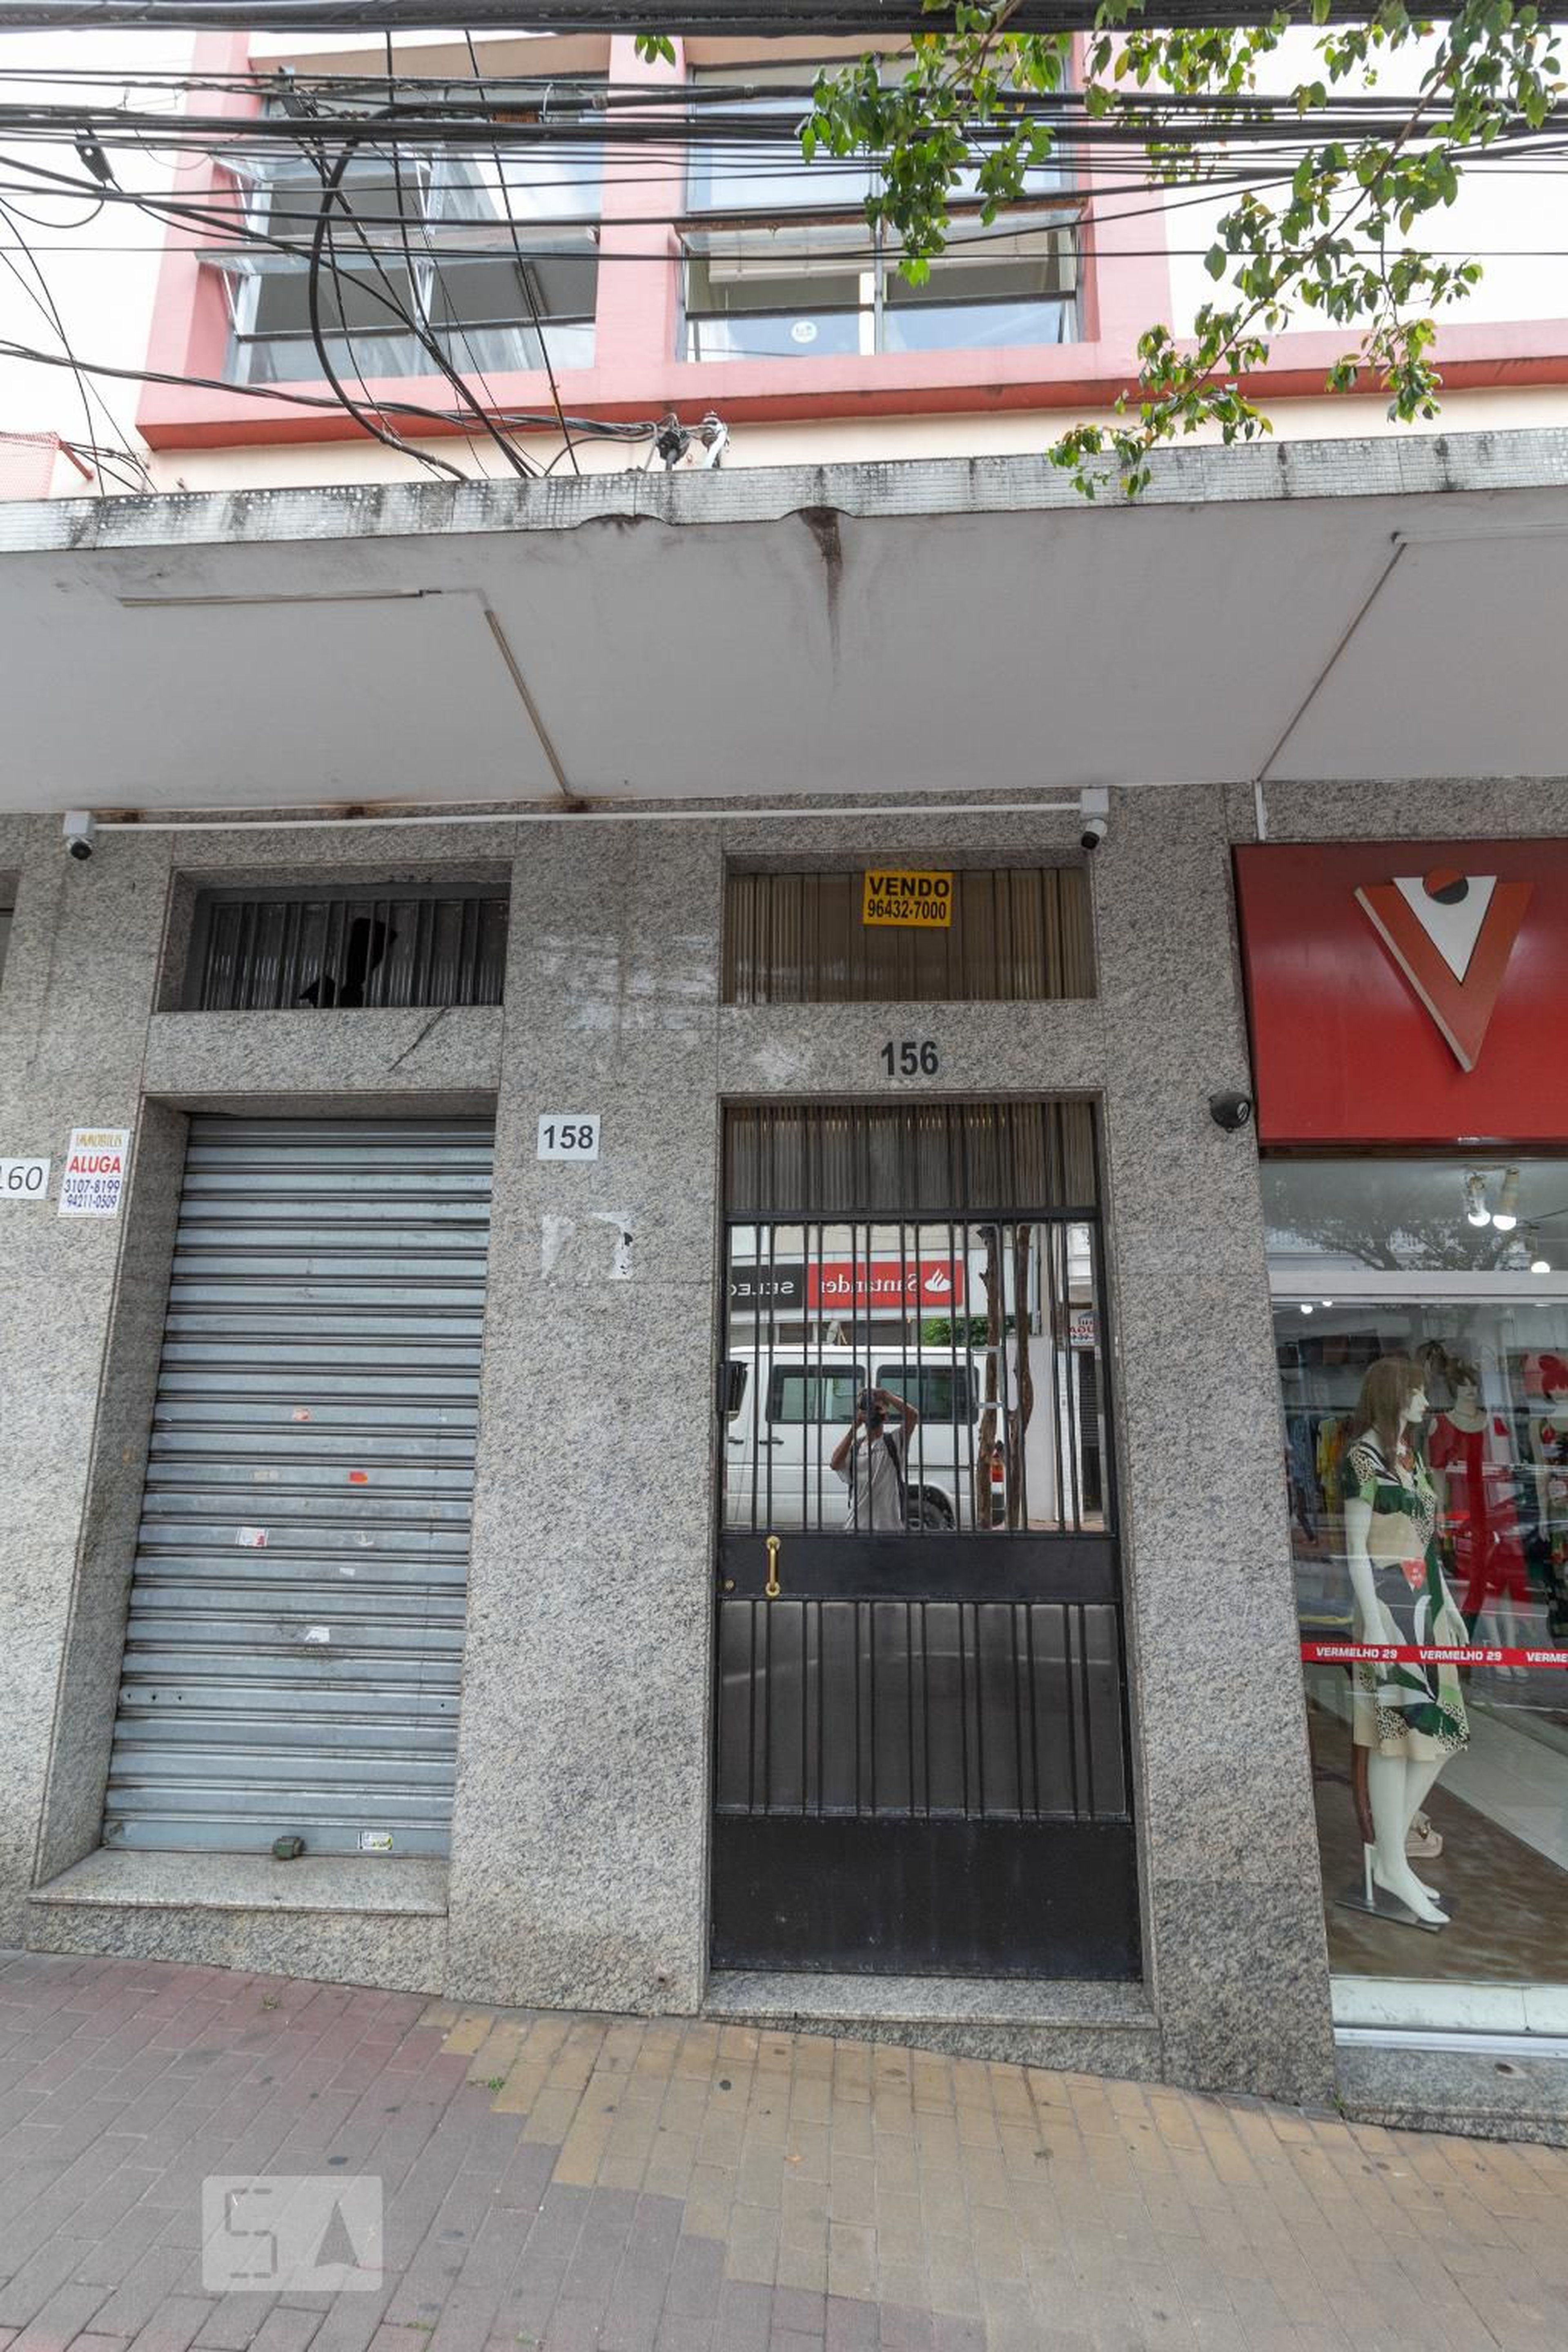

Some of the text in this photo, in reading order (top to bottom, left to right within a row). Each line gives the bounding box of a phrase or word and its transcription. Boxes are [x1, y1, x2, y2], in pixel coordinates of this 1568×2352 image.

[869, 877, 950, 897] VENDO
[881, 1040, 939, 1076] 156
[543, 1125, 593, 1149] 158
[69, 1155, 121, 1173] ALUGA
[64, 1179, 120, 1193] 3107-8199
[1316, 1646, 1398, 1659] VERMELHO 29
[1419, 1649, 1503, 1662] VERMELHO 29
[1526, 1651, 1568, 1663] VERME
